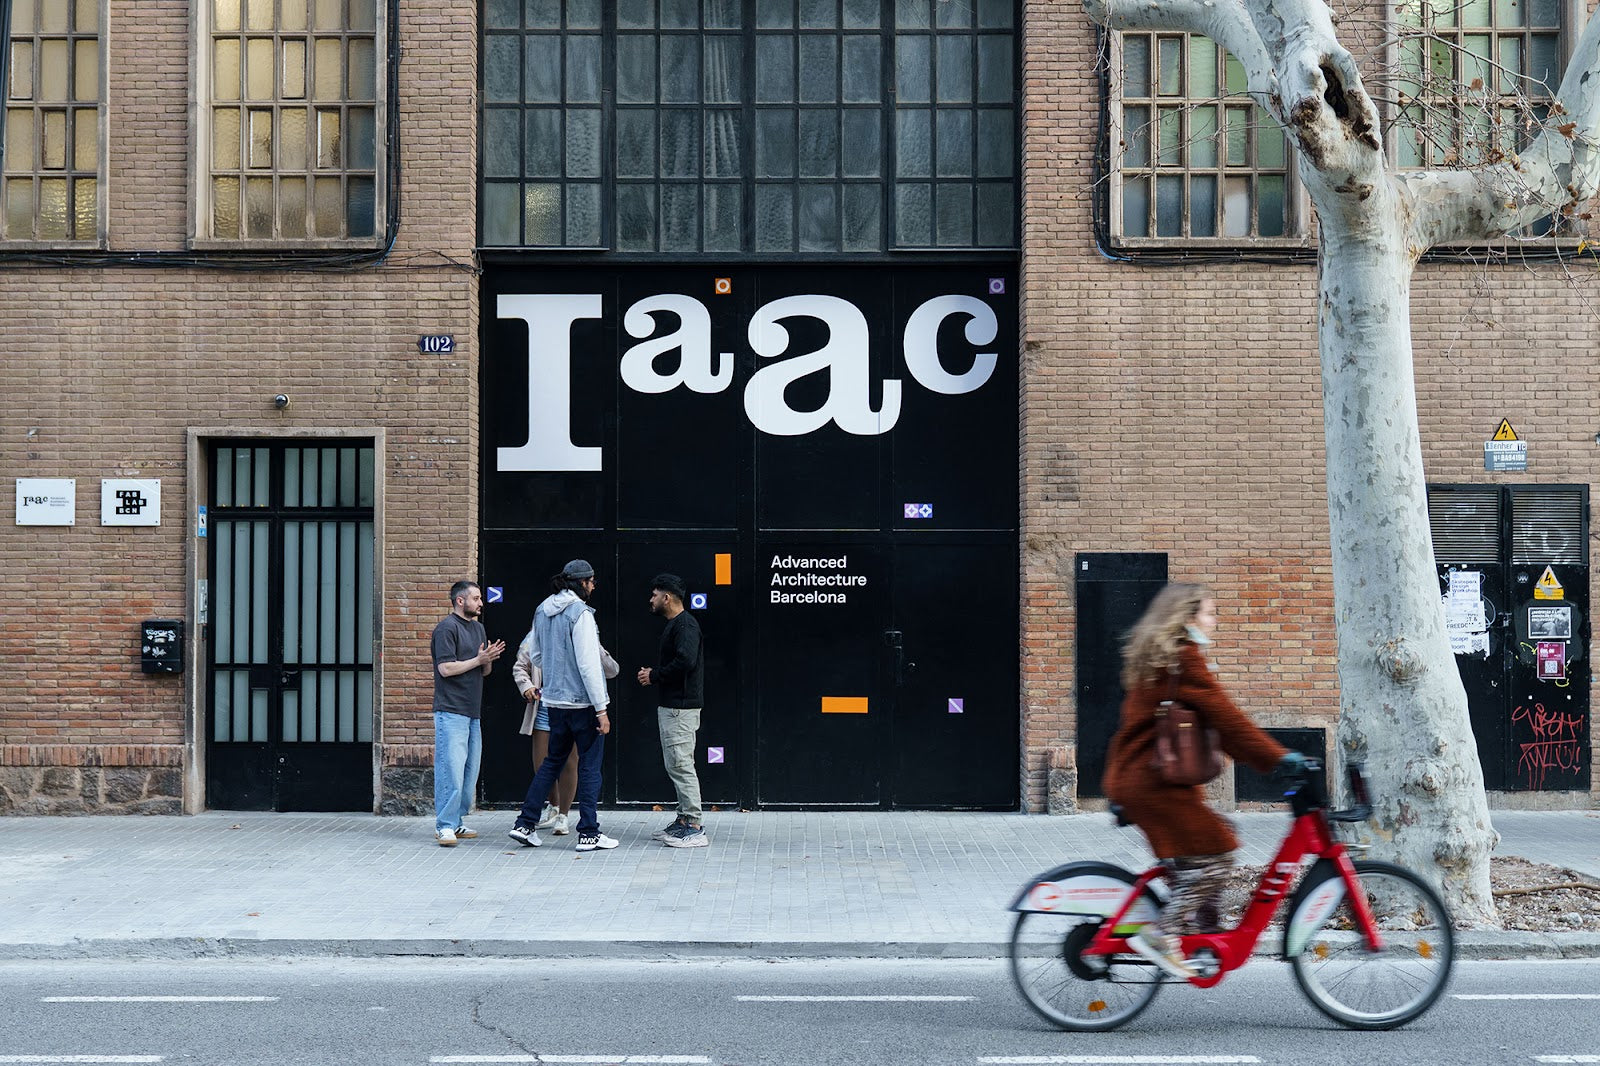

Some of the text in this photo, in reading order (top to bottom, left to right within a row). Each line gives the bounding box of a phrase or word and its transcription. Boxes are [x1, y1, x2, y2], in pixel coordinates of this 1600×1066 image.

[423, 336, 451, 352] 102
[496, 293, 999, 472] Iaac
[770, 555, 847, 569] Advanced
[770, 572, 868, 586] Architecture
[770, 590, 847, 604] Barcelona
[580, 836, 598, 844] MAX
